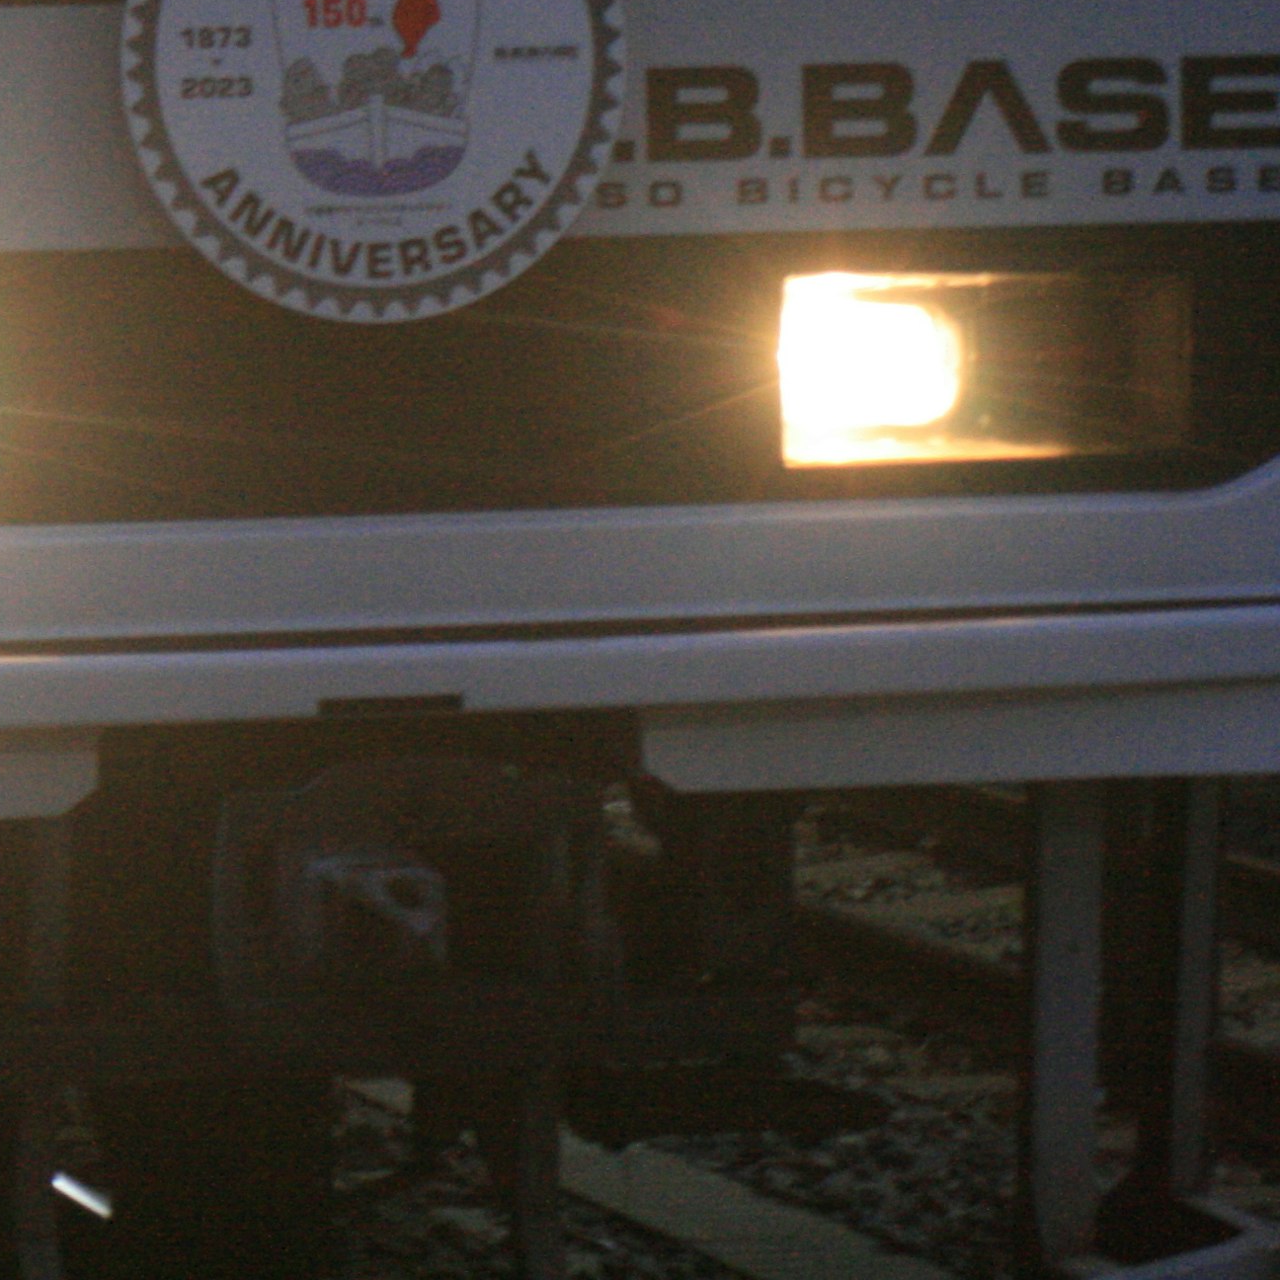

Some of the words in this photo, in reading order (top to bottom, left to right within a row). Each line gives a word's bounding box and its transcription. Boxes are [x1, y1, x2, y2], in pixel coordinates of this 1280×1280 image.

[180, 26, 253, 49] 1873
[180, 77, 254, 100] 2023
[614, 53, 1280, 164] .B.BASE
[595, 180, 684, 210] SO
[737, 170, 1054, 206] BICYCLE
[1101, 165, 1280, 197] BASE
[199, 149, 552, 281] ANNIVERSARY
